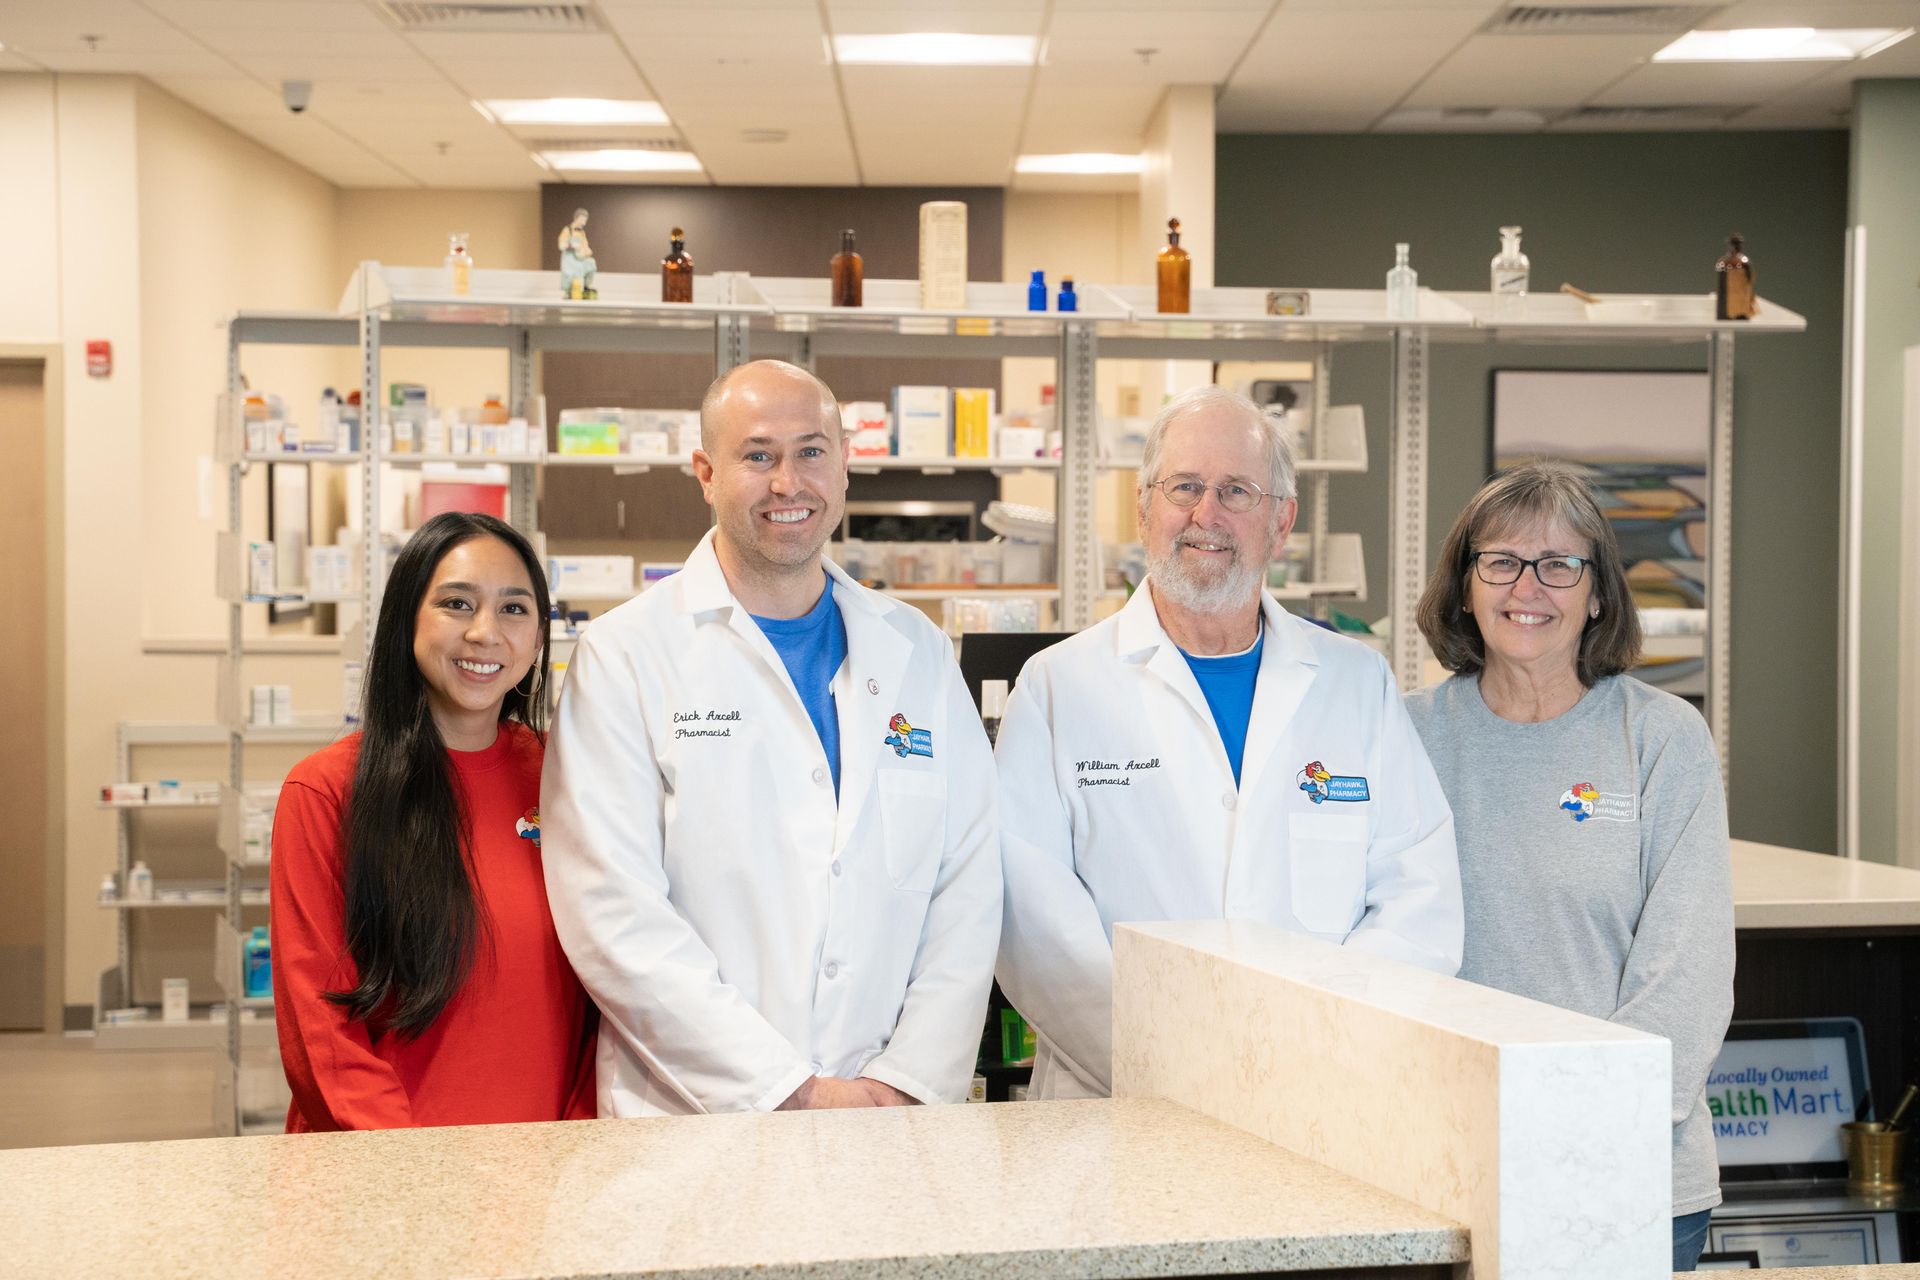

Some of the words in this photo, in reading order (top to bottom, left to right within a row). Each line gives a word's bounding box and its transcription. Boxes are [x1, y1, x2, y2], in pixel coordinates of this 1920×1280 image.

[674, 710, 701, 723] Erick
[706, 710, 741, 721] Axcell
[675, 728, 731, 739] Pharmacist
[1076, 760, 1120, 772] William
[1125, 758, 1160, 770] Axcell
[1078, 777, 1130, 788] Pharmacist
[1706, 1068, 1767, 1086] Locally
[1771, 1065, 1829, 1082] Owned
[1773, 1086, 1845, 1115] Mart
